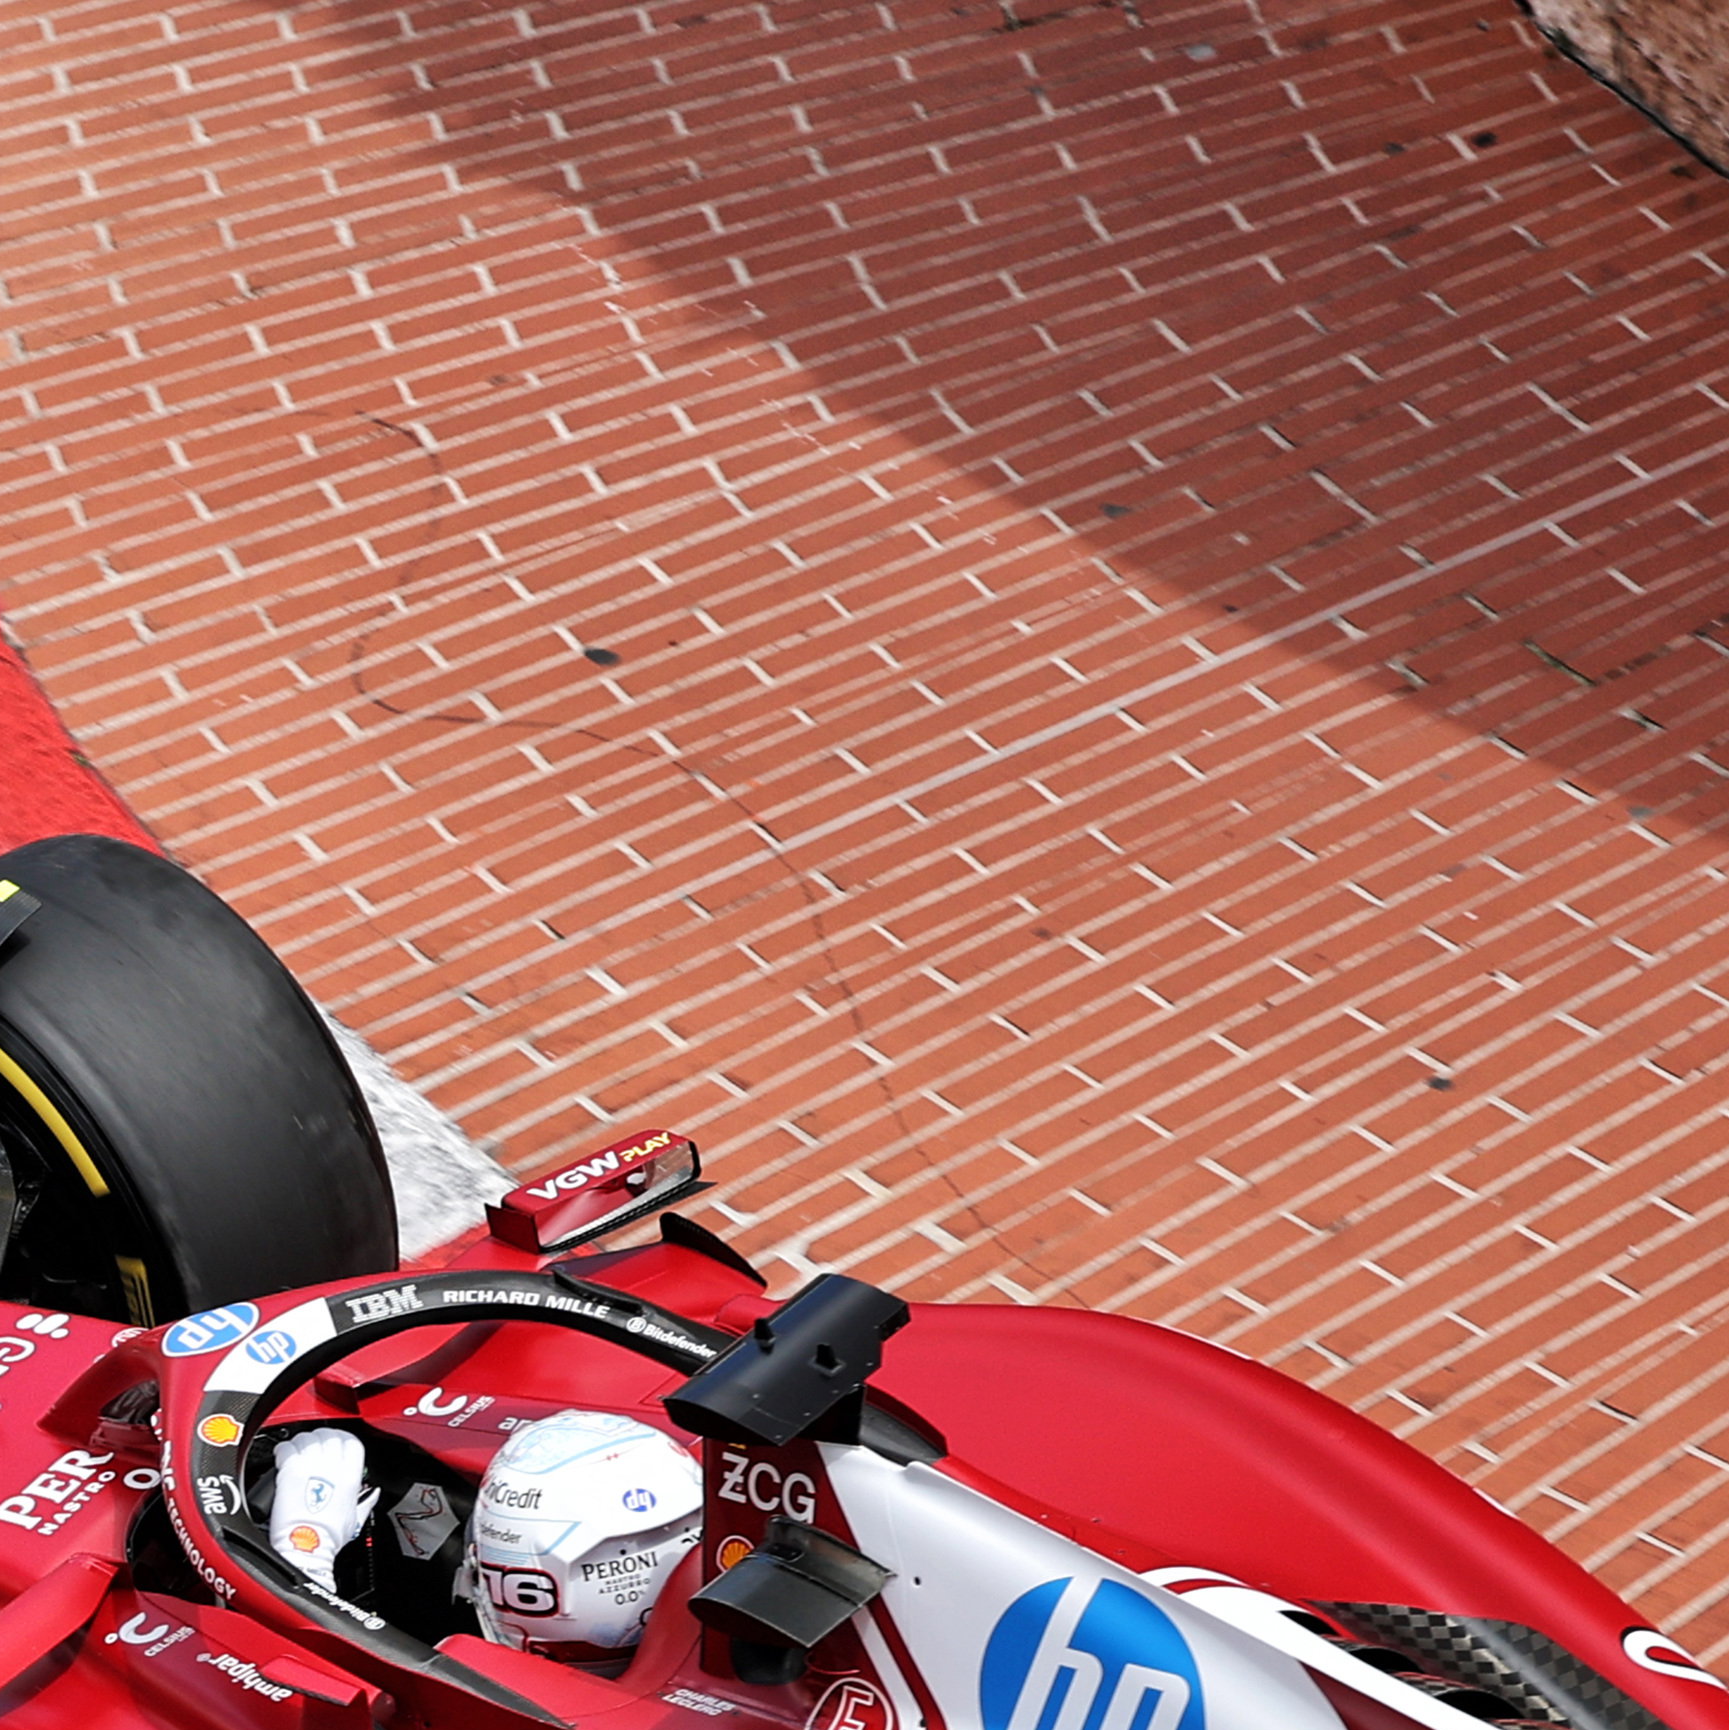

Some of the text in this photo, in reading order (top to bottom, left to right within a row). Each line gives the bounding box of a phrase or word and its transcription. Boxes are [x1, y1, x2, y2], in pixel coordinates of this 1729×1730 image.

[526, 1132, 672, 1200] VGW PLAY
[346, 1285, 423, 1323] IBM
[443, 1290, 611, 1319] RICHARD MILLE
[248, 1331, 293, 1364] hp
[644, 1323, 717, 1359] Bitdefender
[197, 1475, 227, 1515] aws
[168, 1498, 237, 1600] TECHNOLOGY
[581, 1552, 658, 1582] PERONI
[482, 1563, 559, 1616] 16
[661, 1695, 724, 1716] LECLERC
[675, 1689, 736, 1712] CHARLES
